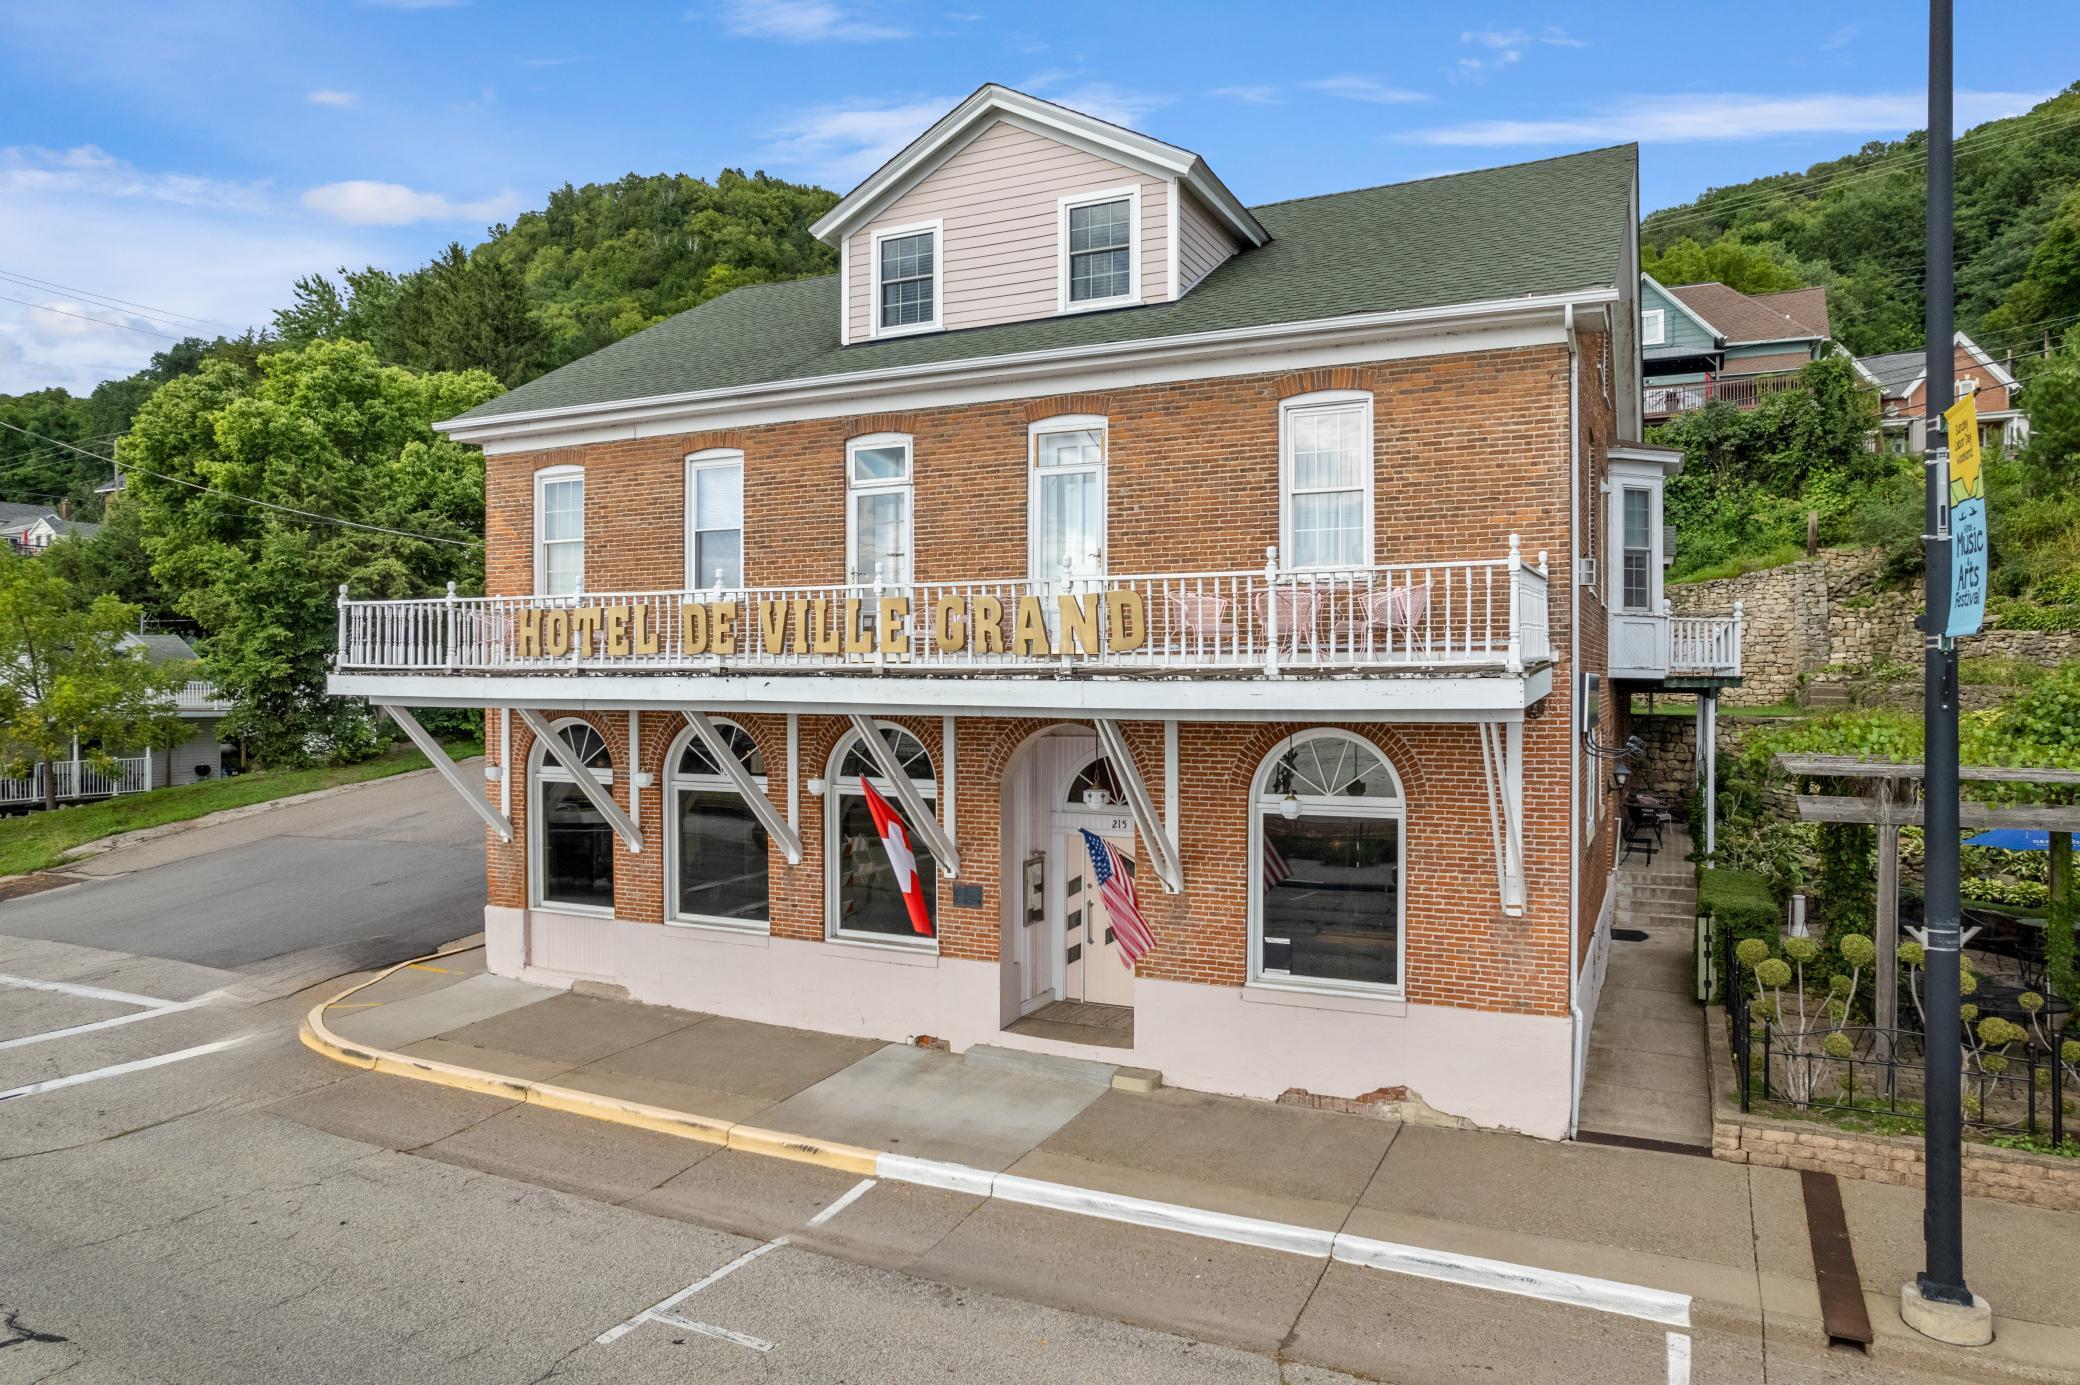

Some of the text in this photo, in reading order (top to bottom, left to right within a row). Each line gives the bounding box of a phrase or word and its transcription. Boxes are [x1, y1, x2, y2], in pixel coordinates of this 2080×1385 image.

[1956, 526, 1983, 558] Music
[1958, 564, 1980, 591] Arts
[1955, 587, 1981, 608] Festival
[518, 590, 1145, 657] HOTEL DE VILLE GRAND
[1111, 819, 1127, 829] 215
